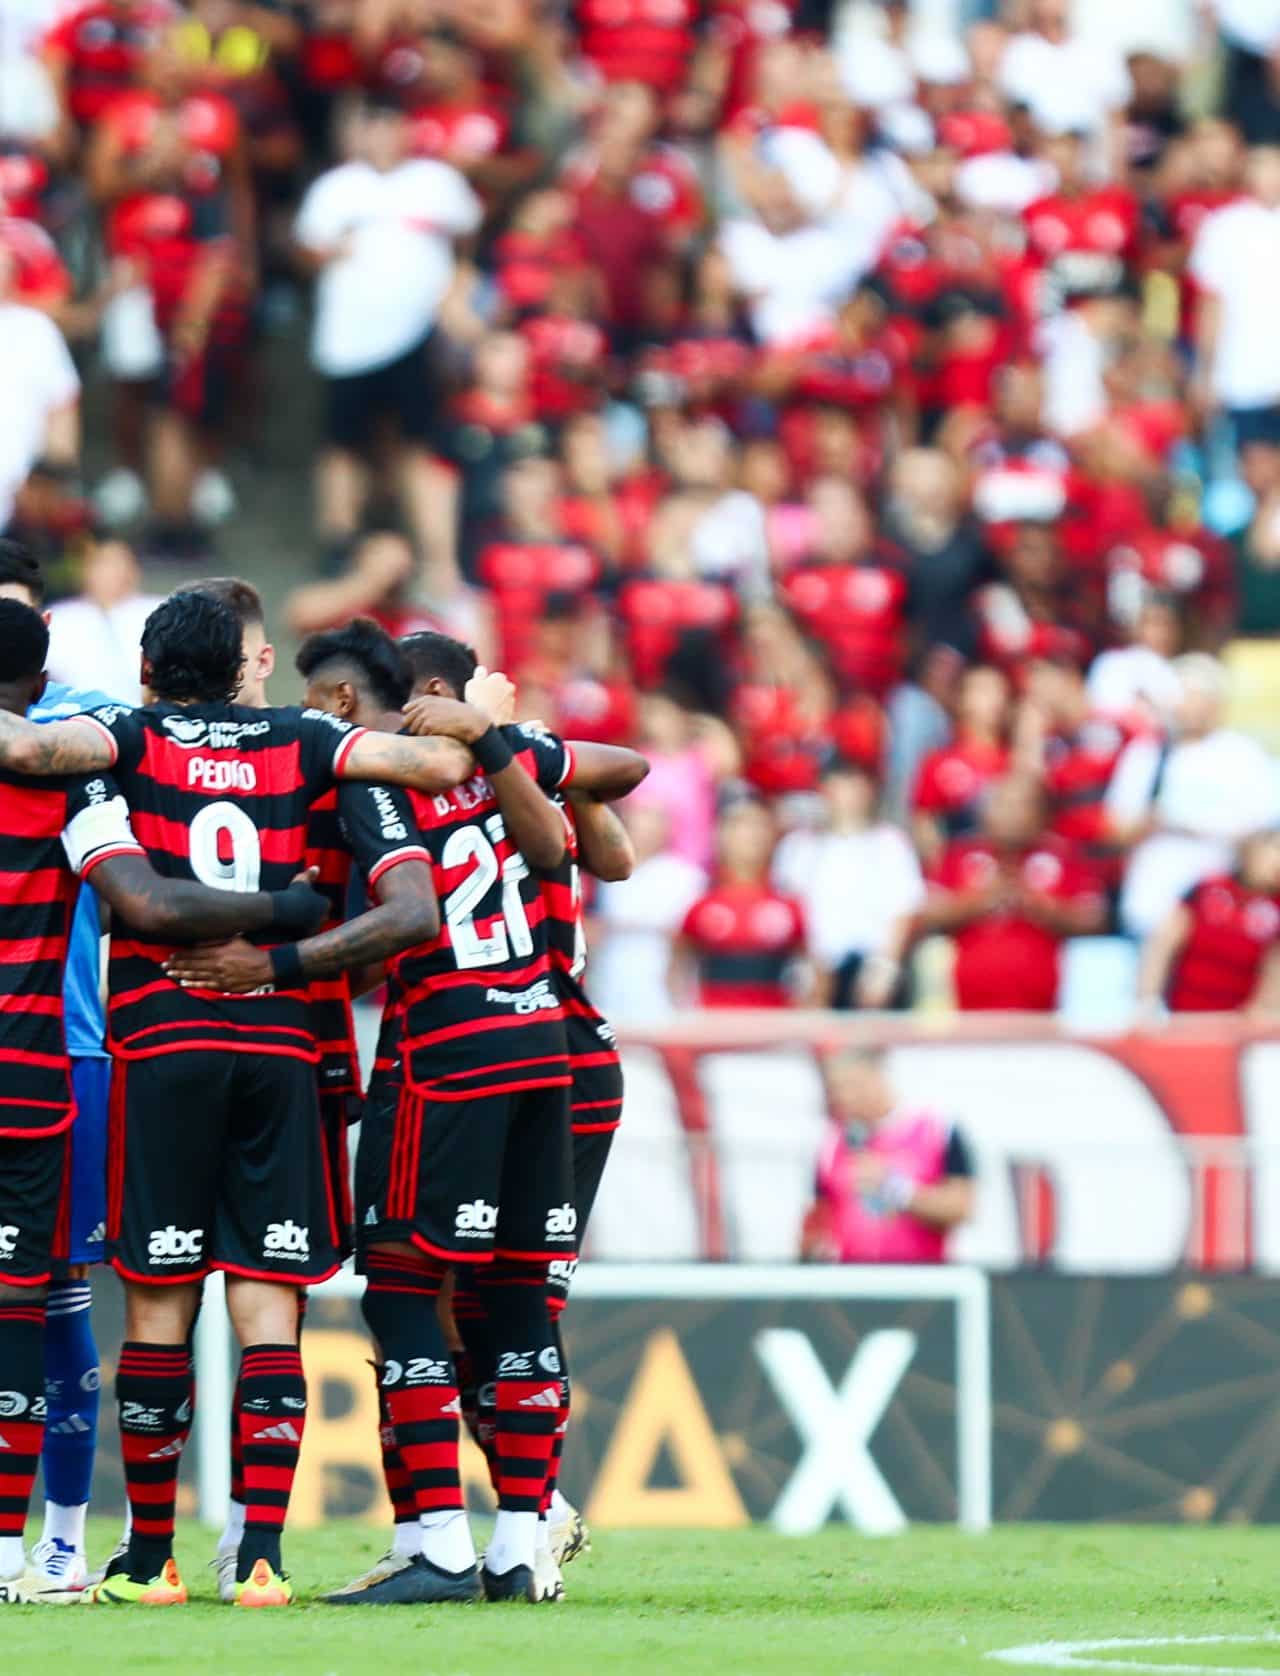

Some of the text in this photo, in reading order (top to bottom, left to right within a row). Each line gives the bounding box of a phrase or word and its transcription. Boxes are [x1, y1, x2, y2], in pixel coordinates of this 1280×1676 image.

[189, 801, 261, 893] 9
[545, 1202, 577, 1233] ab
[147, 1225, 204, 1256] abc
[405, 1357, 449, 1379] Zé
[295, 1328, 917, 1535] BAX
